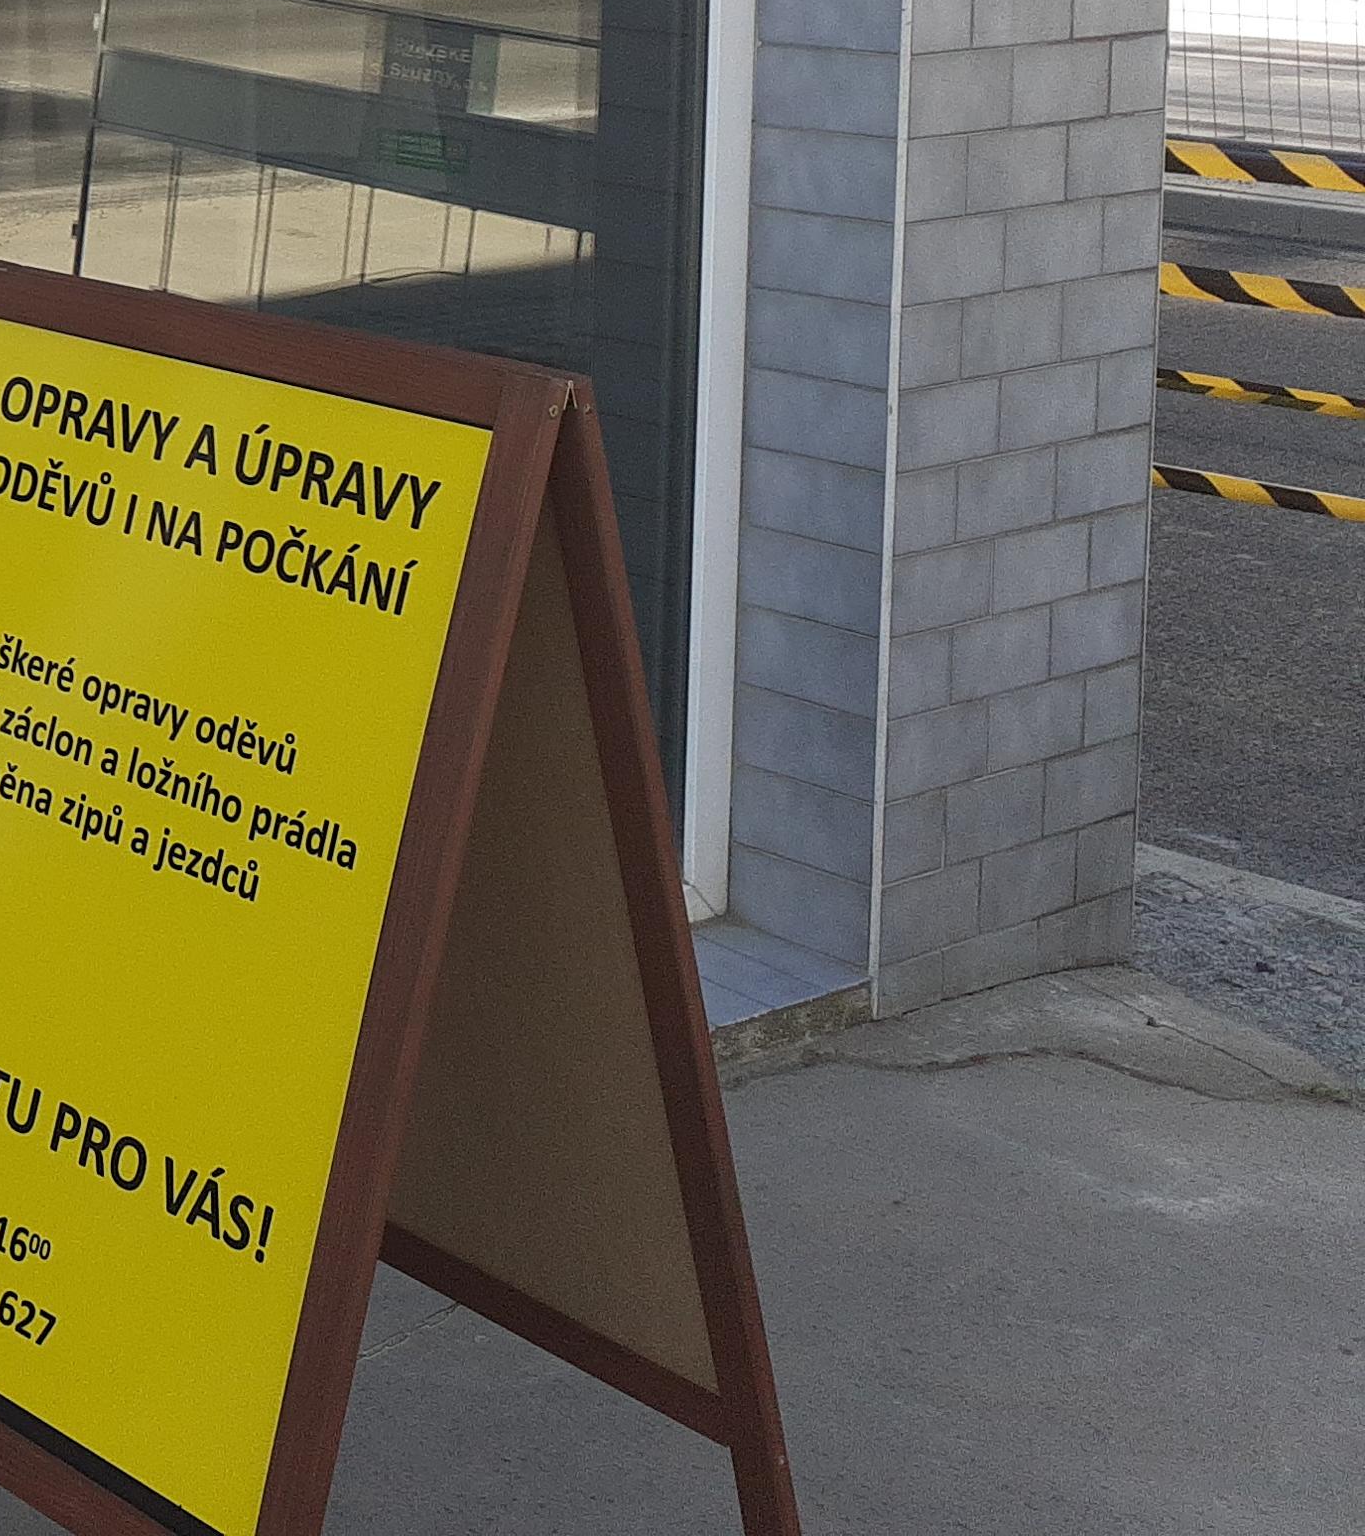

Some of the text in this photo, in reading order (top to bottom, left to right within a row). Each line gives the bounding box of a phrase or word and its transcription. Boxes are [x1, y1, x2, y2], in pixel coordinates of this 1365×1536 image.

[0, 376, 441, 531] OPRAVY A ÚPRAVY
[124, 494, 138, 534] I
[146, 500, 203, 556] NA
[215, 520, 418, 616] POČKÁNÍ
[0, 700, 93, 766] záclon
[100, 746, 119, 776] a
[127, 746, 242, 824] ložního
[247, 802, 358, 870] prádla
[82, 677, 189, 742] opravy
[195, 716, 297, 775] oděvů
[59, 792, 124, 855] zipů
[130, 825, 149, 856] a
[150, 828, 261, 902] jezdců
[49, 1101, 147, 1192] PRO
[163, 1156, 276, 1263] VÁS!
